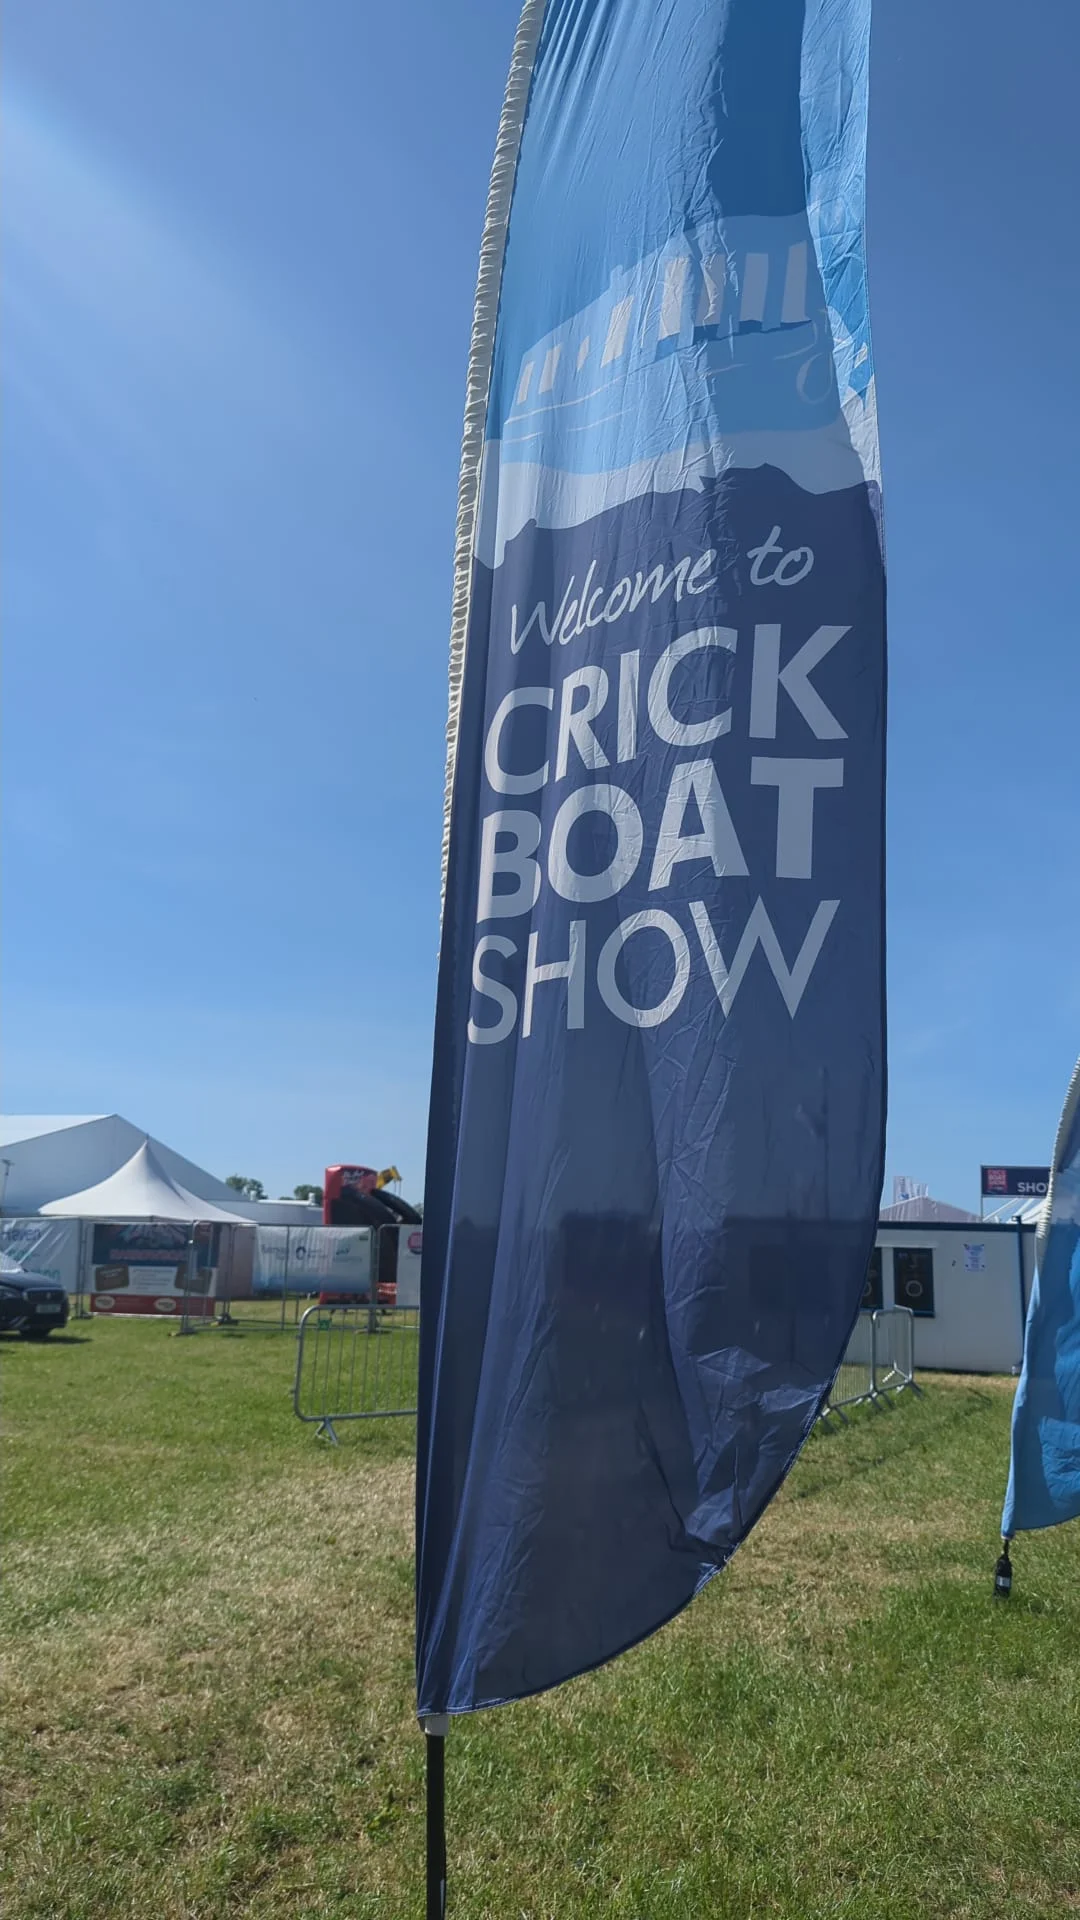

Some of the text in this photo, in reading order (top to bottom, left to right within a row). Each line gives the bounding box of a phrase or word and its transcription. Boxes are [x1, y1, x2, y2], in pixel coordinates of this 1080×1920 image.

[510, 525, 814, 655] Welcome to
[484, 623, 852, 796] CRICK
[476, 756, 845, 924] BOAT
[467, 895, 841, 1045] SHOW
[1017, 1181, 1049, 1193] SHO
